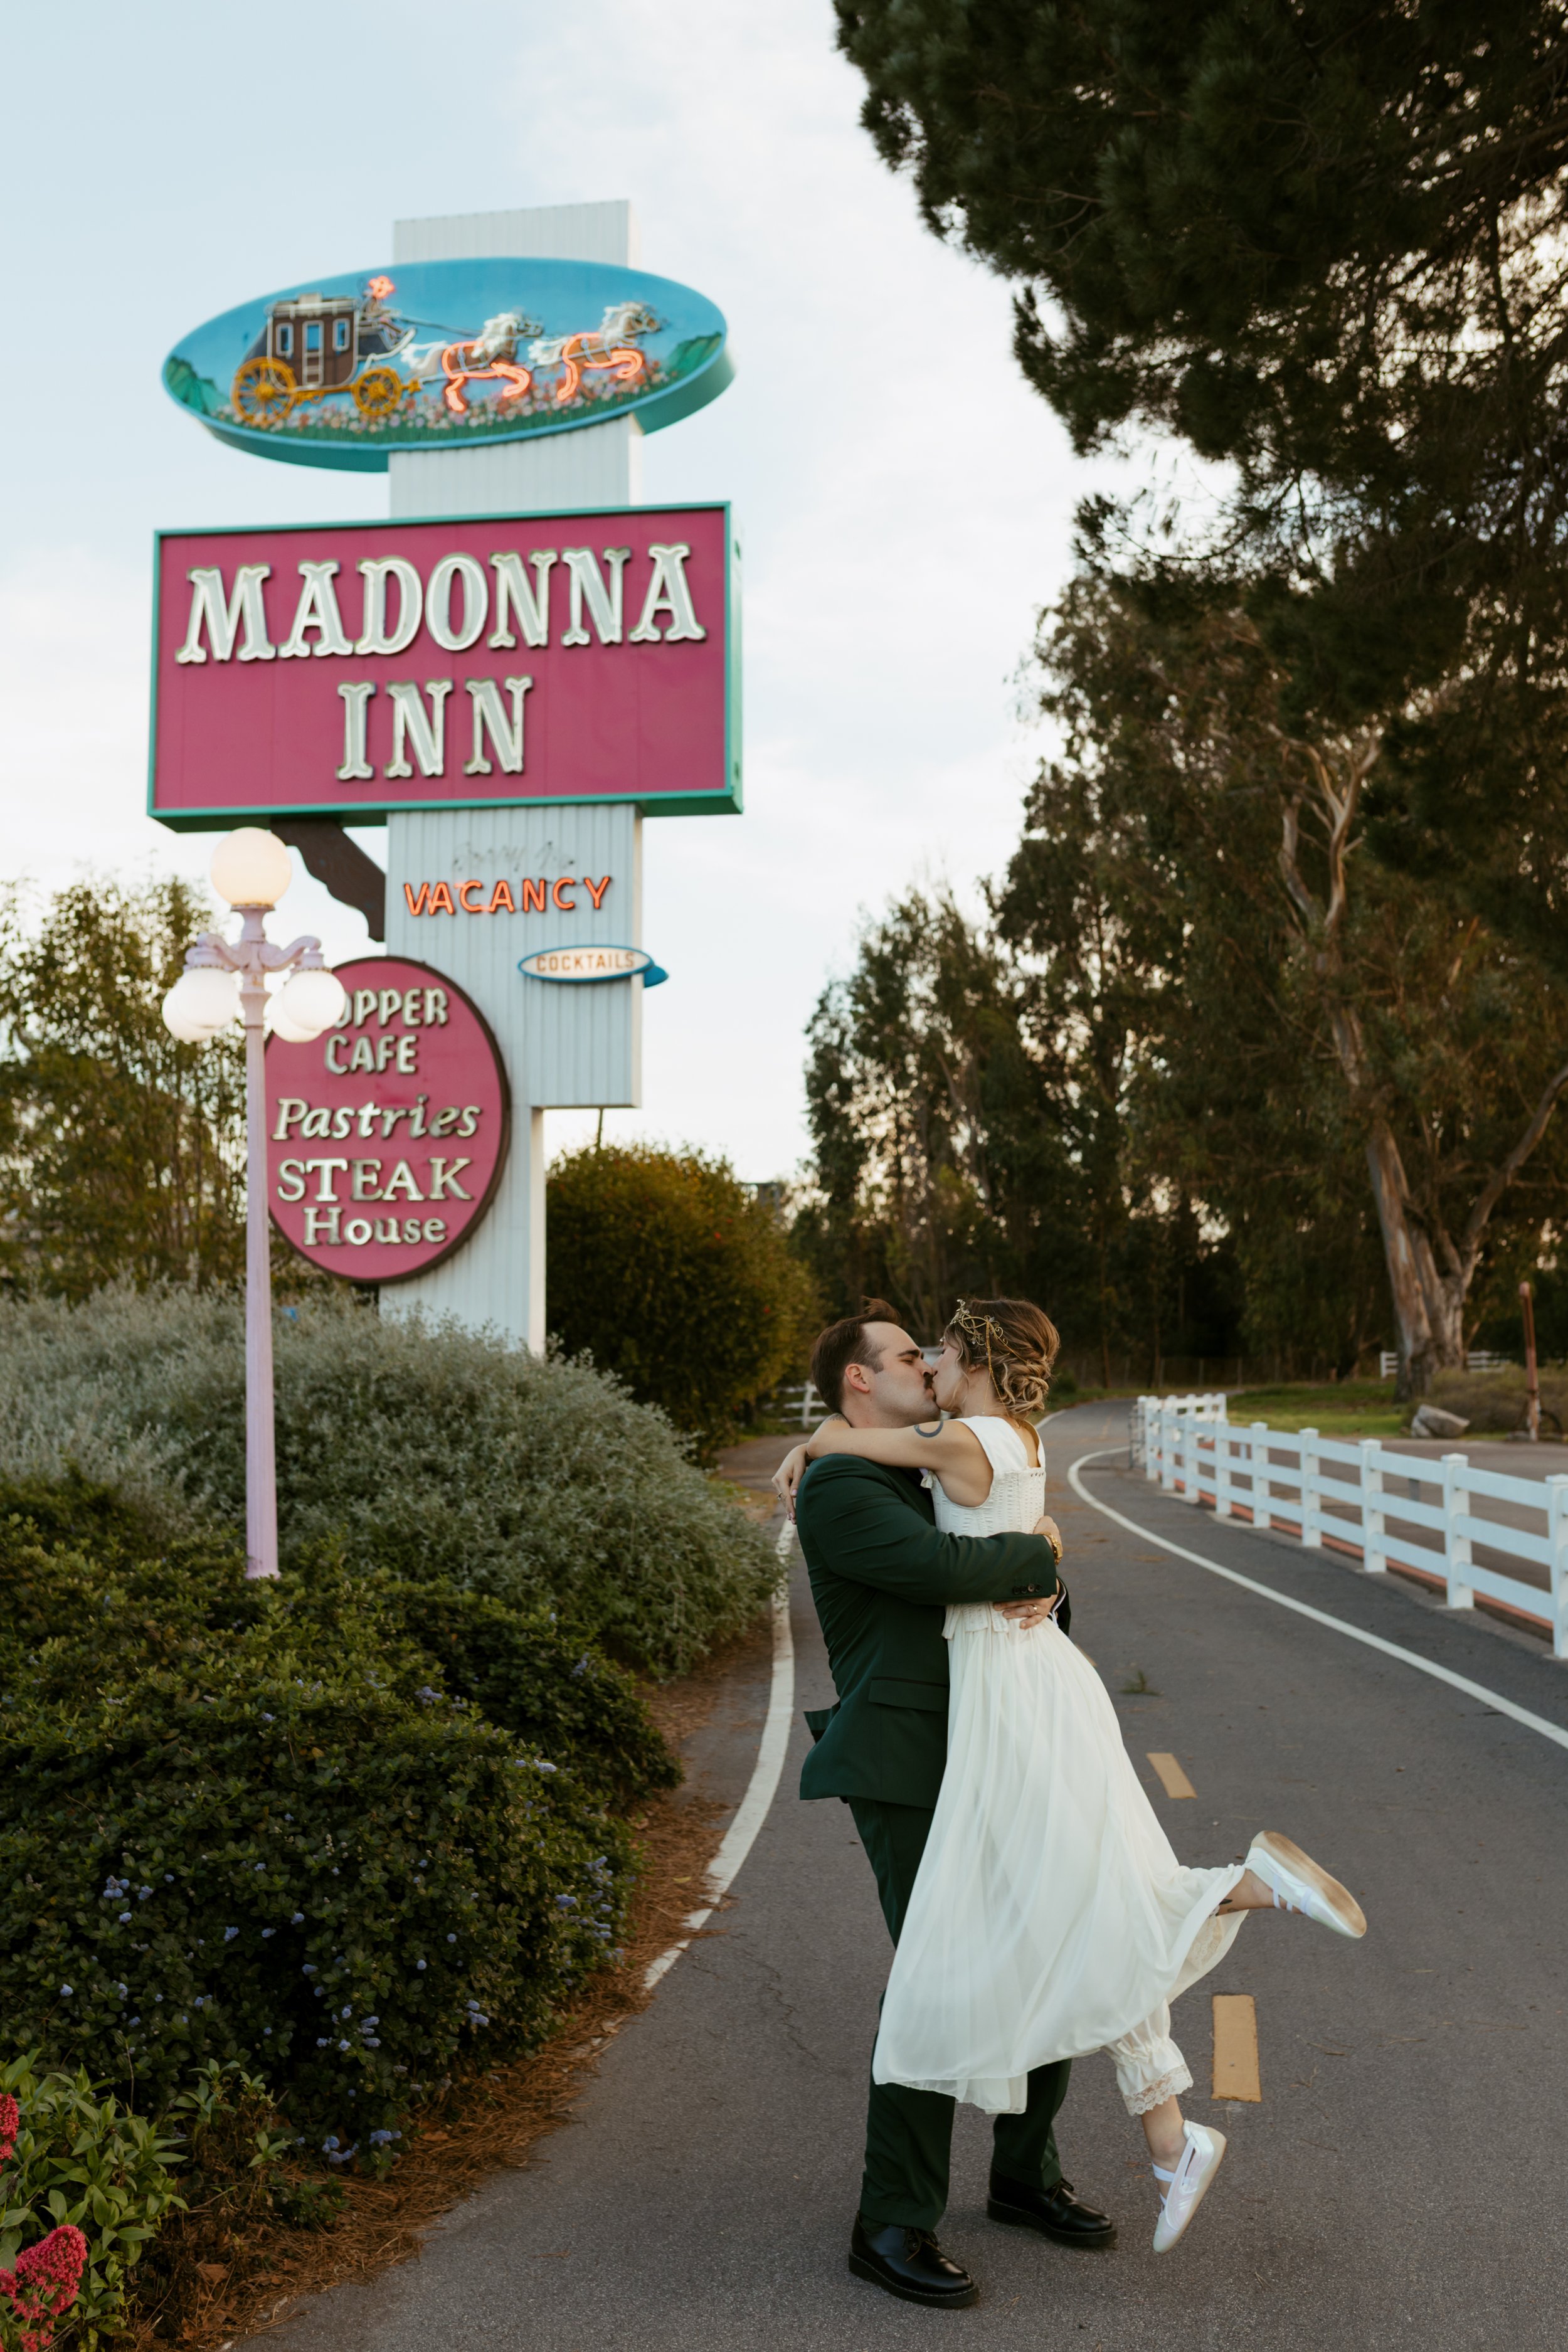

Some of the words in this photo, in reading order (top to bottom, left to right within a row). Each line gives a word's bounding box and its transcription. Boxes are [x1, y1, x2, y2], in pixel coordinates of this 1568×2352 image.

[176, 542, 706, 665] MADONNA
[335, 674, 533, 780] INN
[404, 876, 612, 916] VACANCY
[536, 951, 635, 972] COCKTAILS
[325, 1034, 418, 1075] CAFE
[271, 1093, 482, 1140] Pastries
[277, 1158, 475, 1202] STEAK
[302, 1207, 447, 1246] House
